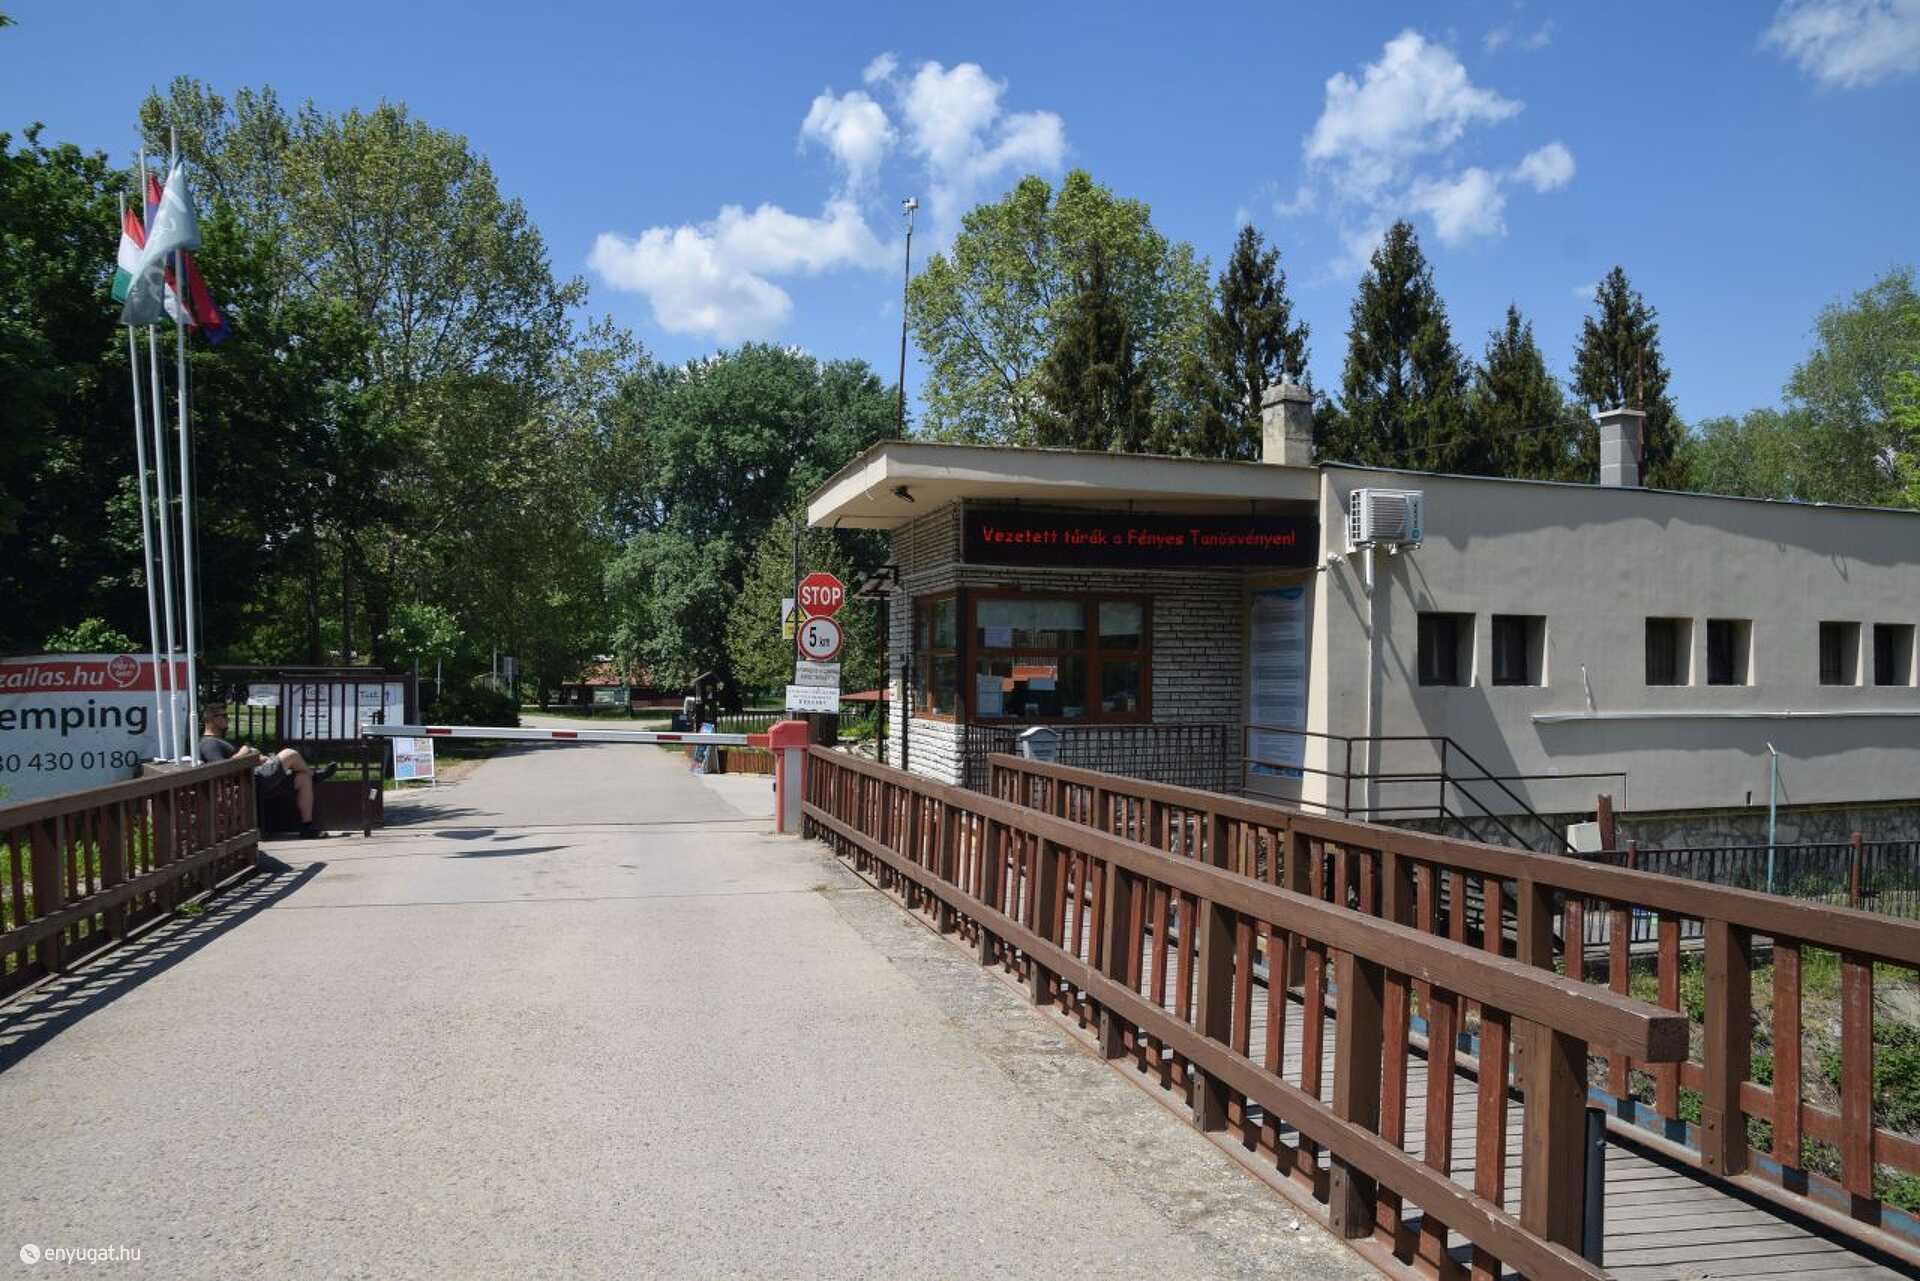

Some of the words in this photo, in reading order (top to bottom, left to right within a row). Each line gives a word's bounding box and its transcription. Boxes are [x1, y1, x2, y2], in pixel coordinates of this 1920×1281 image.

[983, 526, 1058, 545] Vezetett
[1112, 533, 1123, 545] a
[1127, 528, 1185, 548] Fényes
[802, 586, 841, 606] STOP
[809, 626, 817, 647] 5
[0, 699, 148, 737] emping
[28, 752, 73, 771] 430
[81, 750, 139, 770] 0180
